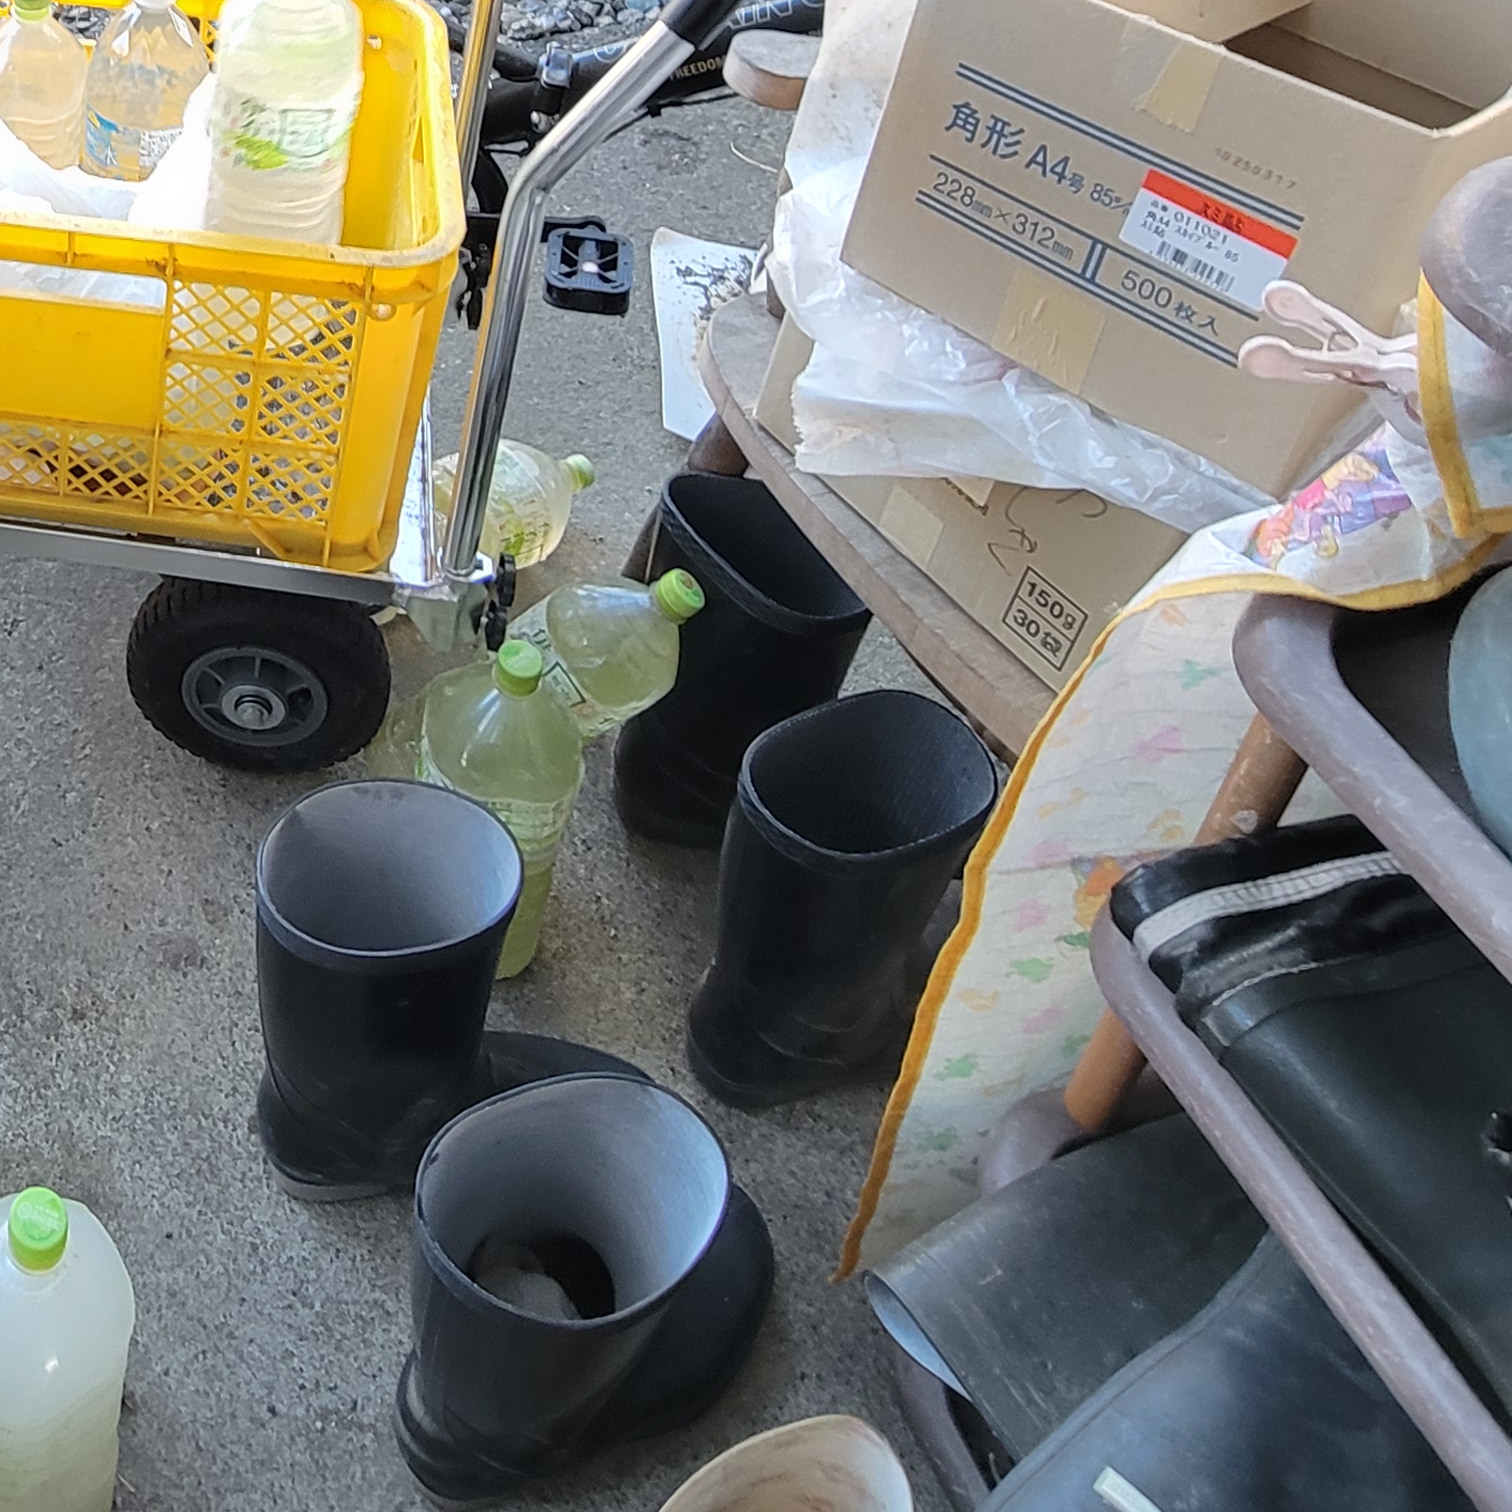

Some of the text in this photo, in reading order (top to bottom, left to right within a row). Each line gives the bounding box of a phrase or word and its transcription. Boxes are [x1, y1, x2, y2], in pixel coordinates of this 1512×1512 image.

[944, 101, 1025, 159] 角形
[1024, 144, 1085, 194] A4号
[1027, 580, 1077, 631] 150g
[1013, 608, 1064, 658] 30袋
